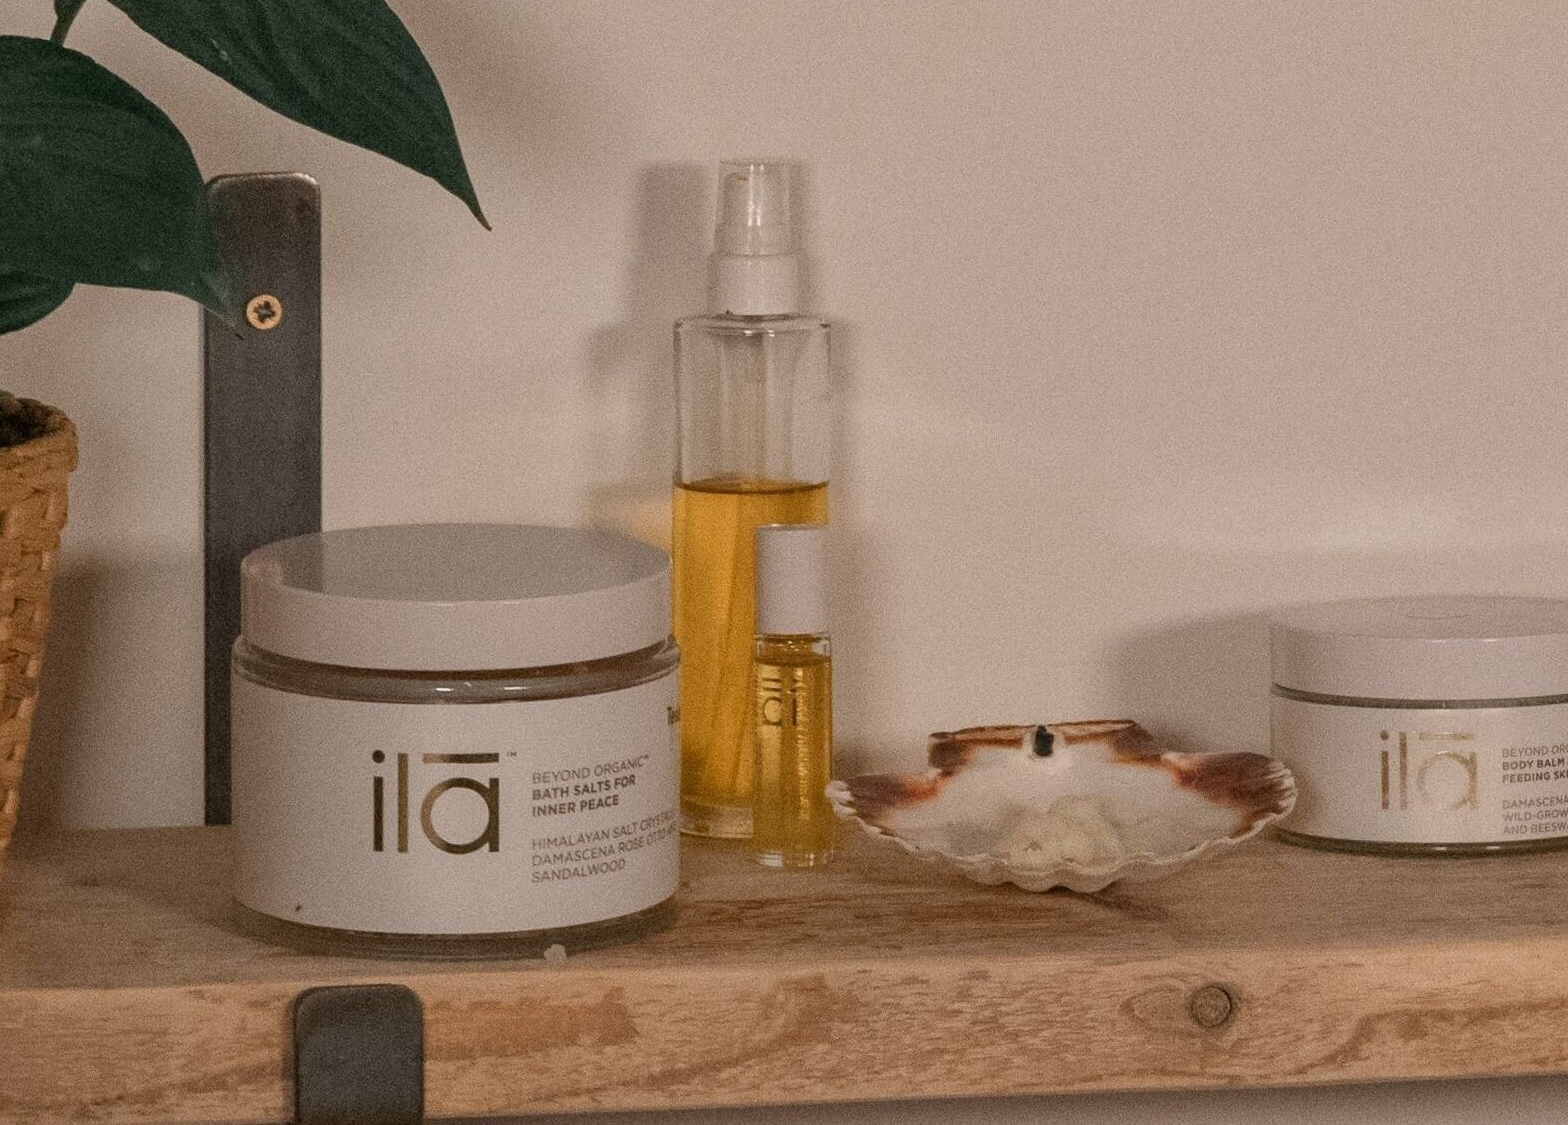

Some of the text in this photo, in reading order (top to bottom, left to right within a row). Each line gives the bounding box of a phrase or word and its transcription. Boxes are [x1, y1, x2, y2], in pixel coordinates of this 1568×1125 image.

[1502, 746, 1549, 758] BEYOND
[1502, 760, 1534, 771] BODY
[1537, 757, 1565, 769] BALM
[531, 767, 591, 785] BEYOND
[1502, 771, 1551, 783] FEEDING
[532, 774, 636, 801] BATH SALTS FOR
[532, 794, 620, 818] INNER PEACE
[1502, 795, 1568, 810] DAMASCENA
[532, 828, 610, 850] HIMALAYAN
[613, 821, 638, 838] SALT
[1502, 825, 1528, 835] AND
[532, 845, 616, 867] DAMASCENA
[618, 835, 645, 853] ROSE
[531, 858, 626, 883] SANDALWOOD
